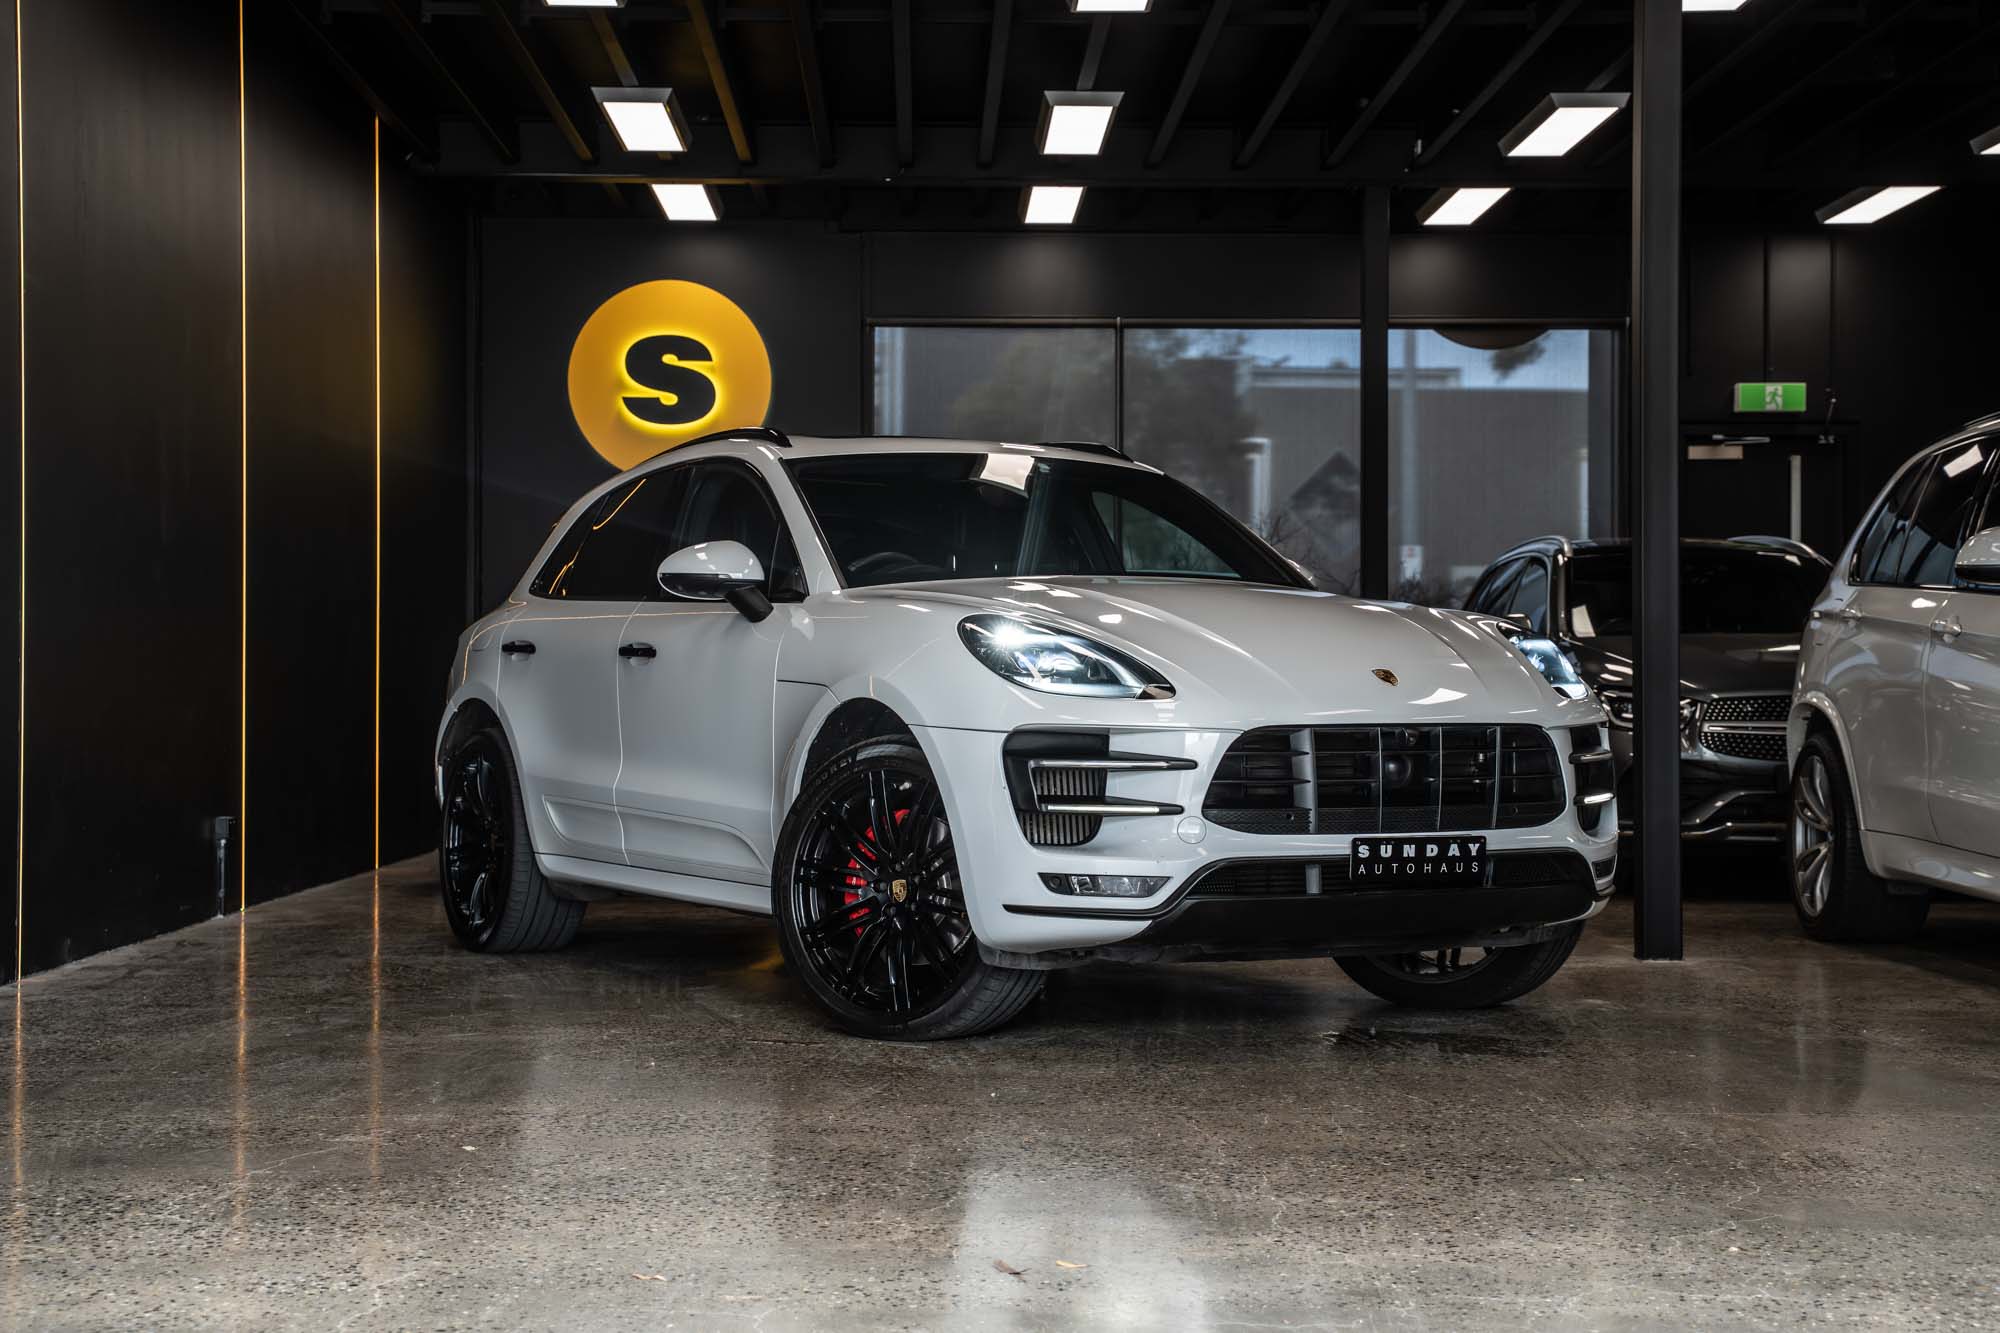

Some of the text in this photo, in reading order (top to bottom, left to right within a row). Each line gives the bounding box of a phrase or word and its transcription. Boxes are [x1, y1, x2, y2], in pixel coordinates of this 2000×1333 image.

[621, 334, 717, 425] S
[1357, 843, 1480, 858] SUNDAY
[1357, 861, 1479, 875] AUTOHAUS
